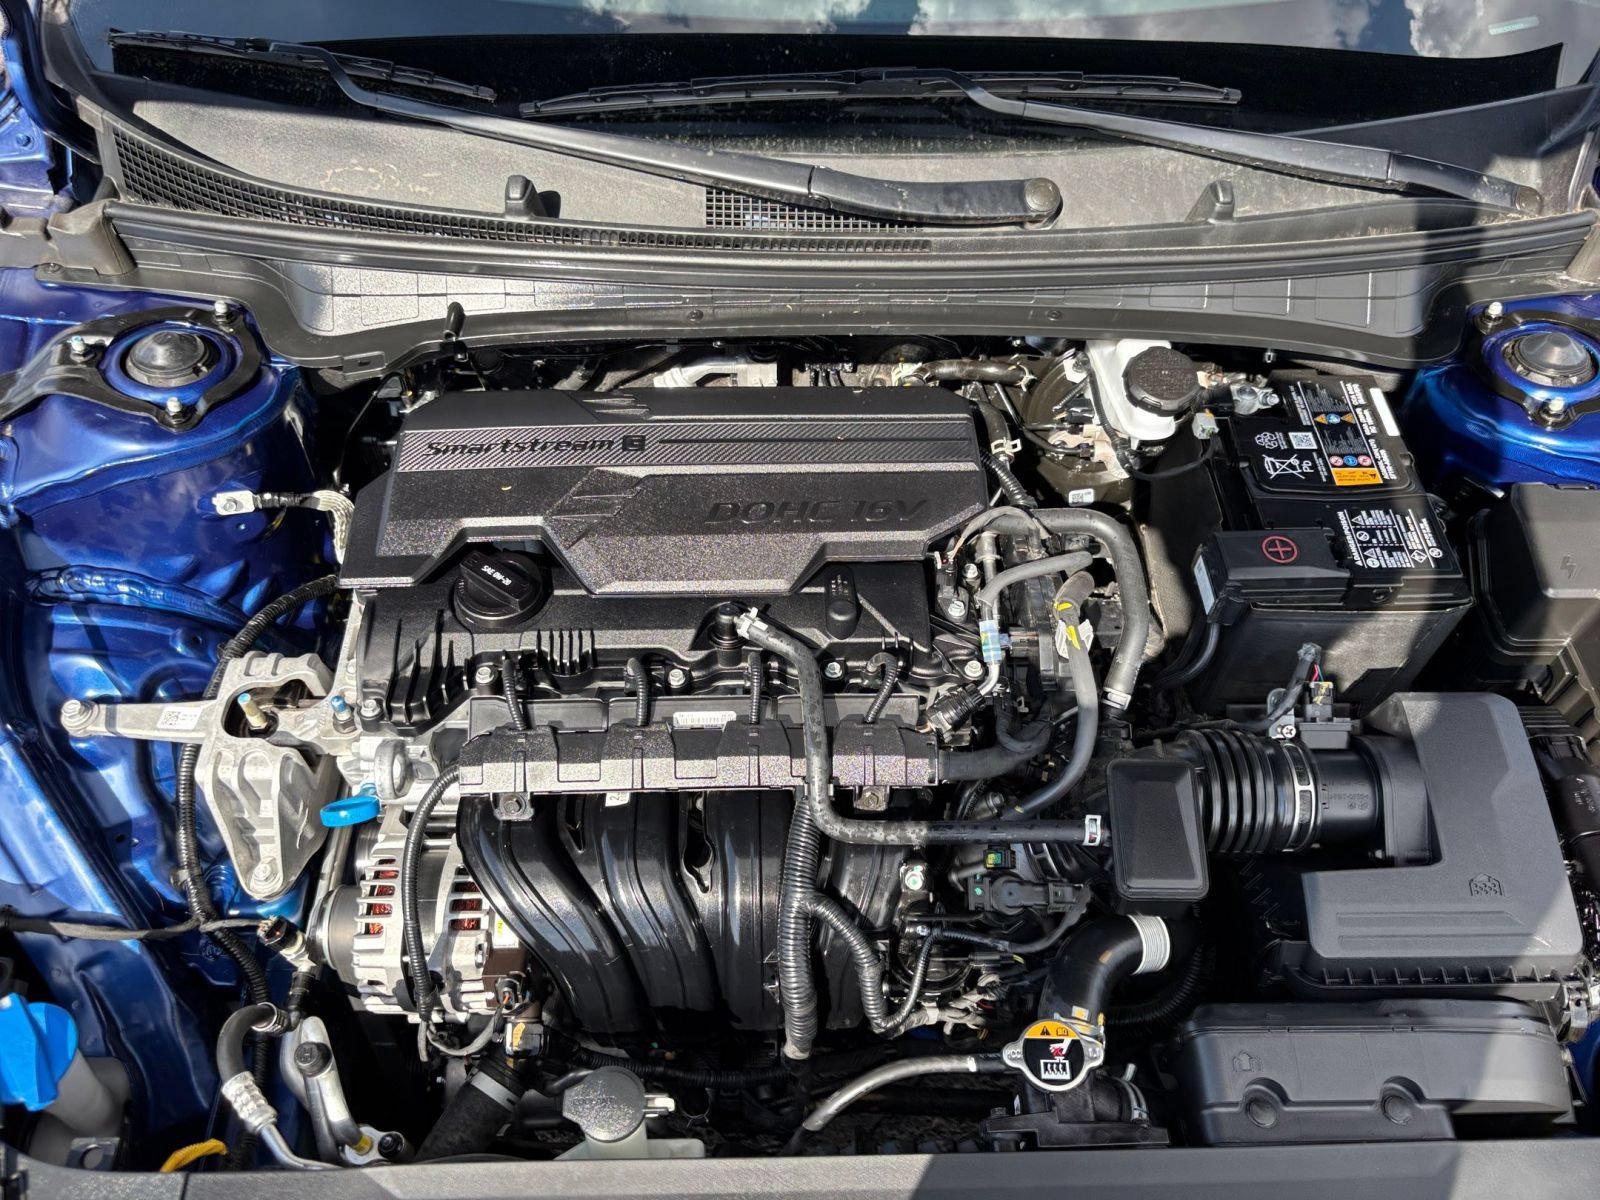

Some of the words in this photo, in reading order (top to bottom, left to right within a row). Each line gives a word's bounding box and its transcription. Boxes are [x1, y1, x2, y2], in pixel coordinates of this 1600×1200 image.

[423, 437, 615, 456] Smartstream
[1301, 460, 1315, 473] Pb
[704, 500, 841, 524] DOHC
[850, 499, 927, 522] 16V
[1337, 511, 1361, 561] DANGER/POISON
[481, 565, 496, 576] SAE
